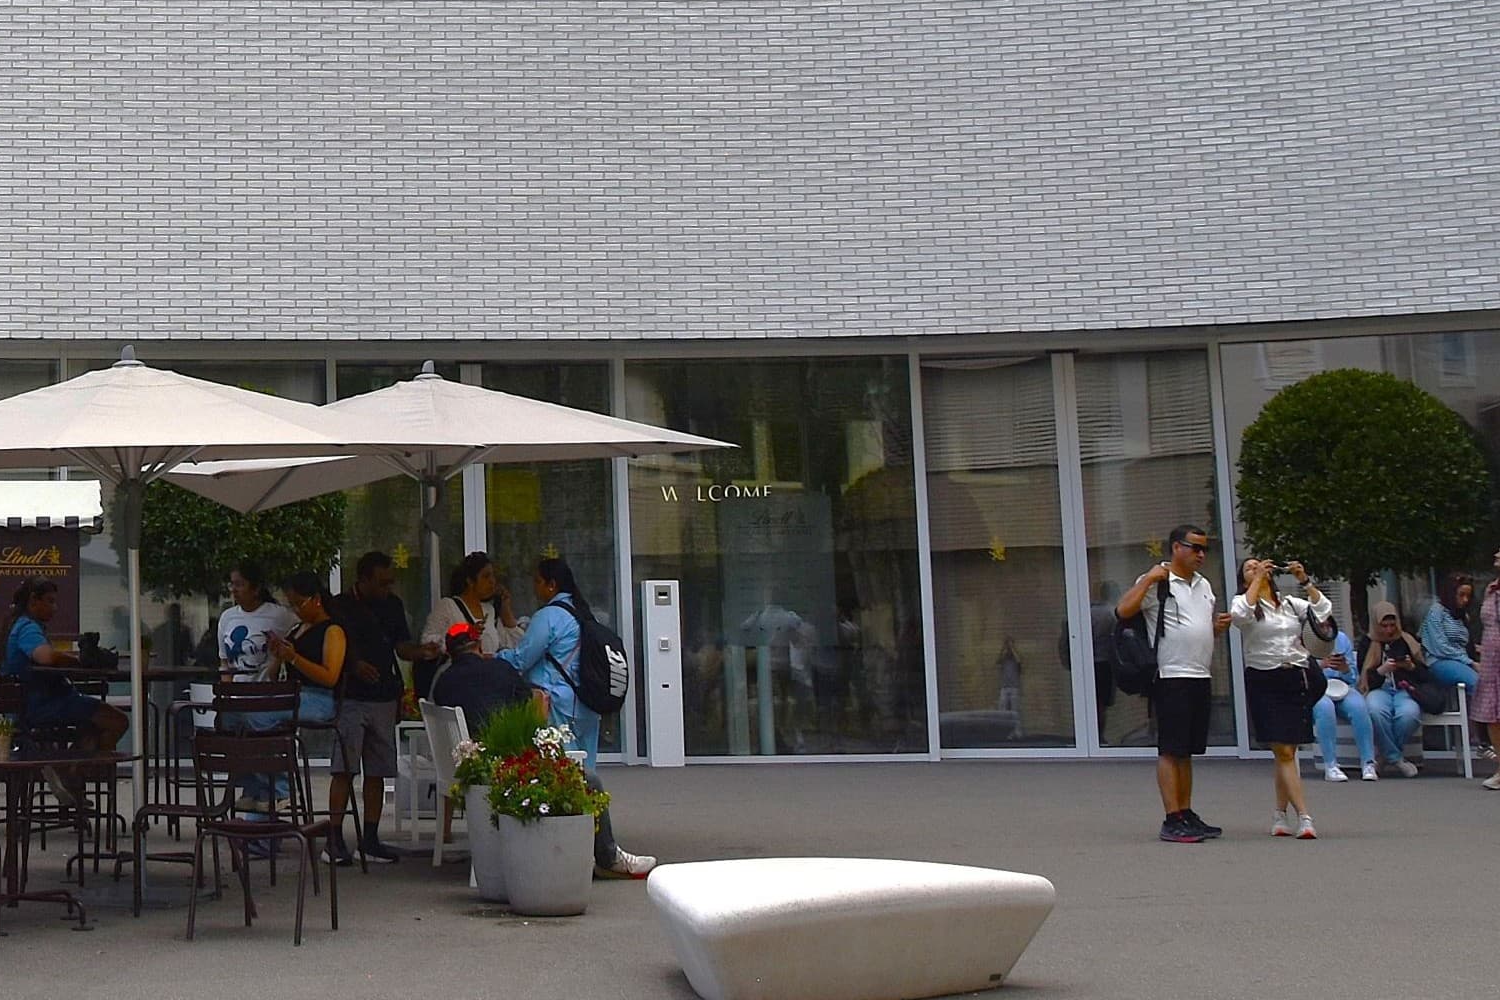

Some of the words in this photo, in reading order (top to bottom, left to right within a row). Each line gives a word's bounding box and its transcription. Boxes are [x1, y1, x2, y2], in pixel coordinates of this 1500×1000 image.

[661, 484, 772, 502] WLCOME
[12, 568, 21, 576] OF
[23, 568, 68, 576] CHOCOLATE
[605, 644, 628, 698] NIKE
